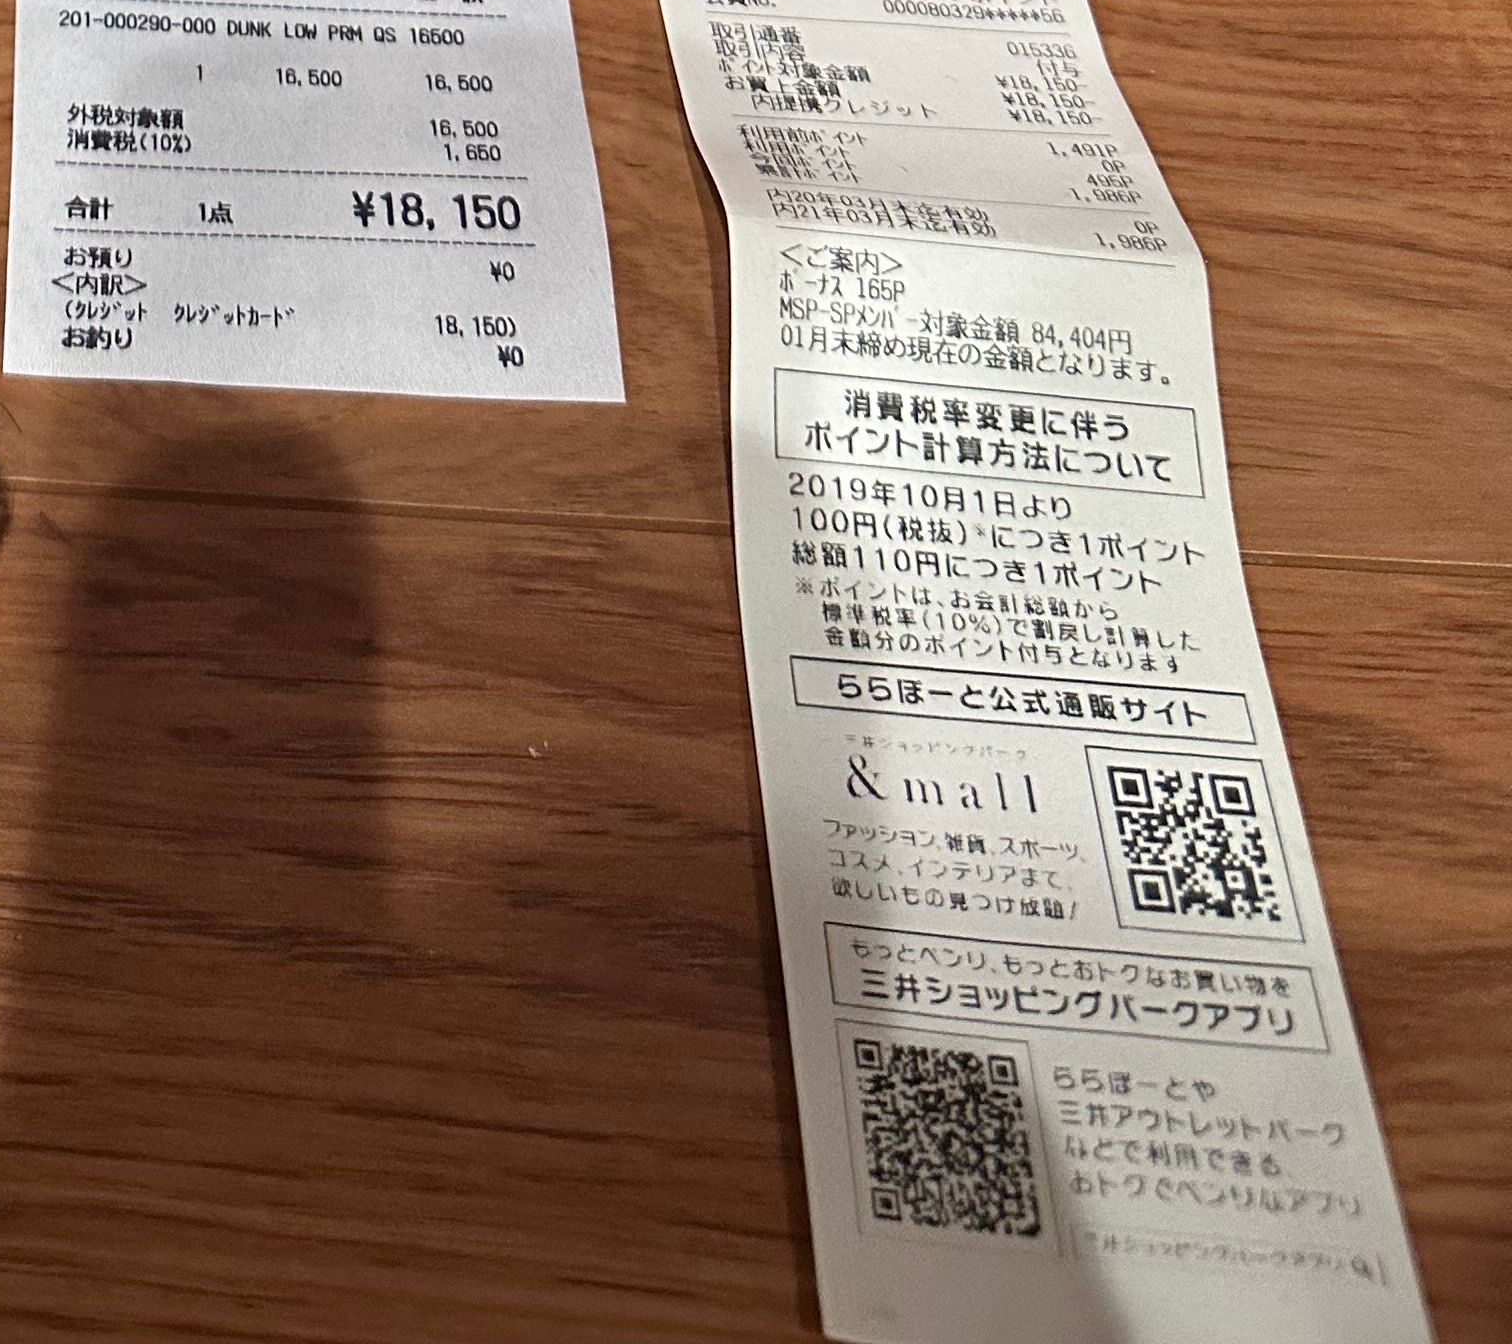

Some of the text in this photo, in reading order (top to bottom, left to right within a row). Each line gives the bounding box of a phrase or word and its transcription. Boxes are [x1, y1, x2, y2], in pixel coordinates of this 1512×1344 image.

[59, 11, 216, 35] 201-000290-000
[226, 20, 272, 40] DUNK
[284, 22, 318, 40] LOW
[328, 24, 363, 42] PRM
[196, 64, 204, 81] 1
[67, 102, 184, 130] 外税対象額
[65, 195, 114, 220] 合計
[198, 200, 234, 224] 1点
[63, 246, 515, 283] お預り ¥0
[857, 277, 905, 302] 165P
[61, 325, 524, 368] お釣り ¥0
[1032, 322, 1133, 356] 84,404円
[844, 388, 1129, 441] 消費税率変更に伴う
[805, 420, 1172, 483] ポイント計算方法について
[788, 471, 1072, 520] 2019年10月1日より
